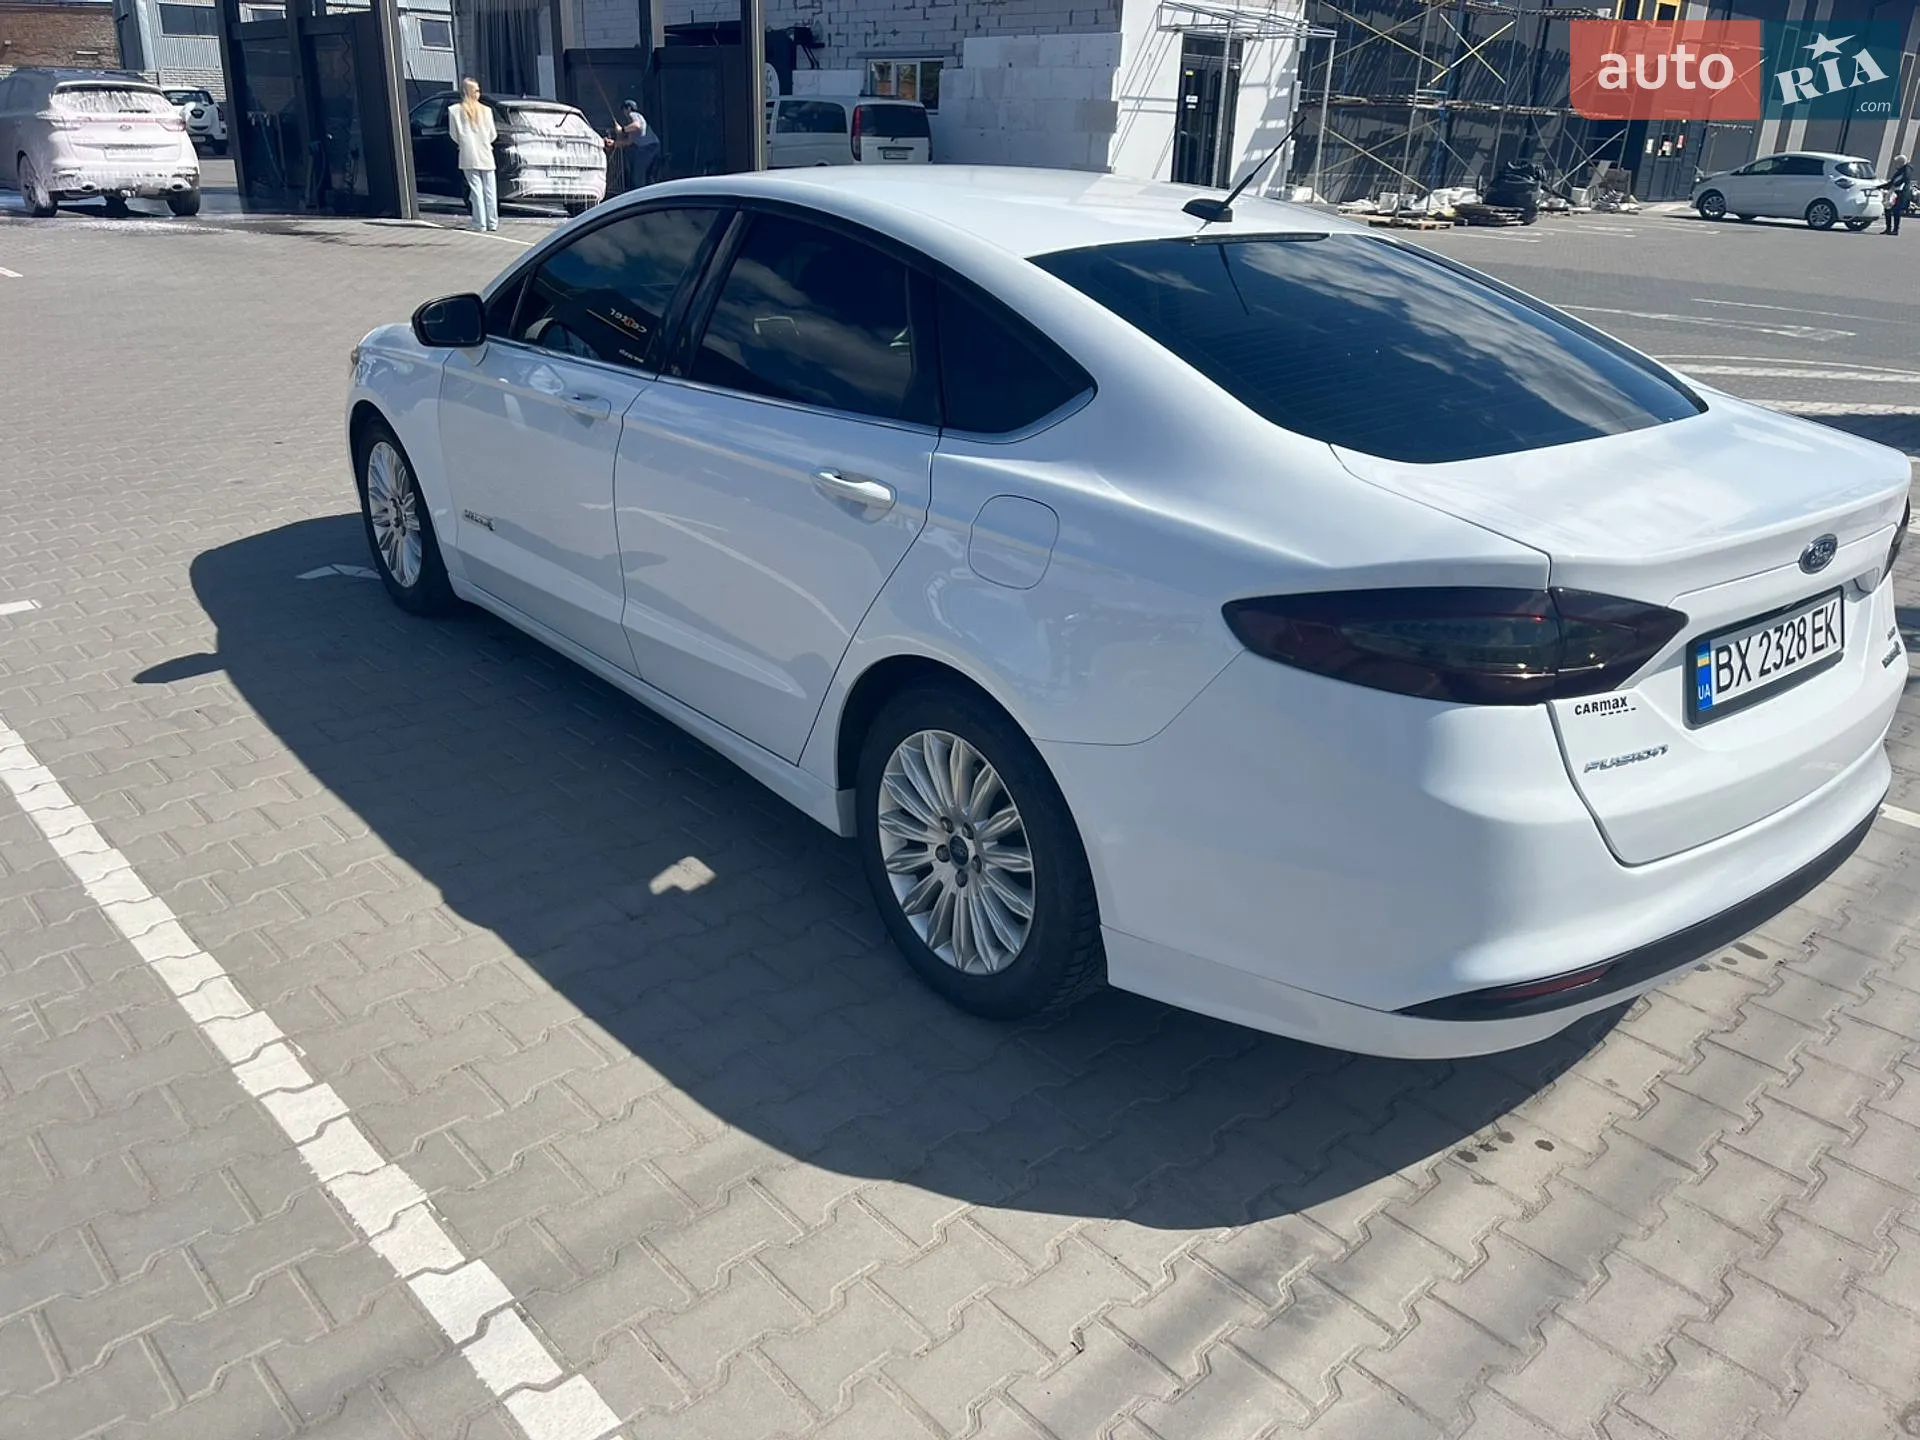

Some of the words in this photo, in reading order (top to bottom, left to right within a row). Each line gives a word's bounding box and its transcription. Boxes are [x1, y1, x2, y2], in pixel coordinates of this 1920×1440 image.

[1714, 635, 1752, 695] BX
[1758, 615, 1807, 678] 2328
[1811, 601, 1837, 655] EK
[1697, 683, 1712, 700] UA
